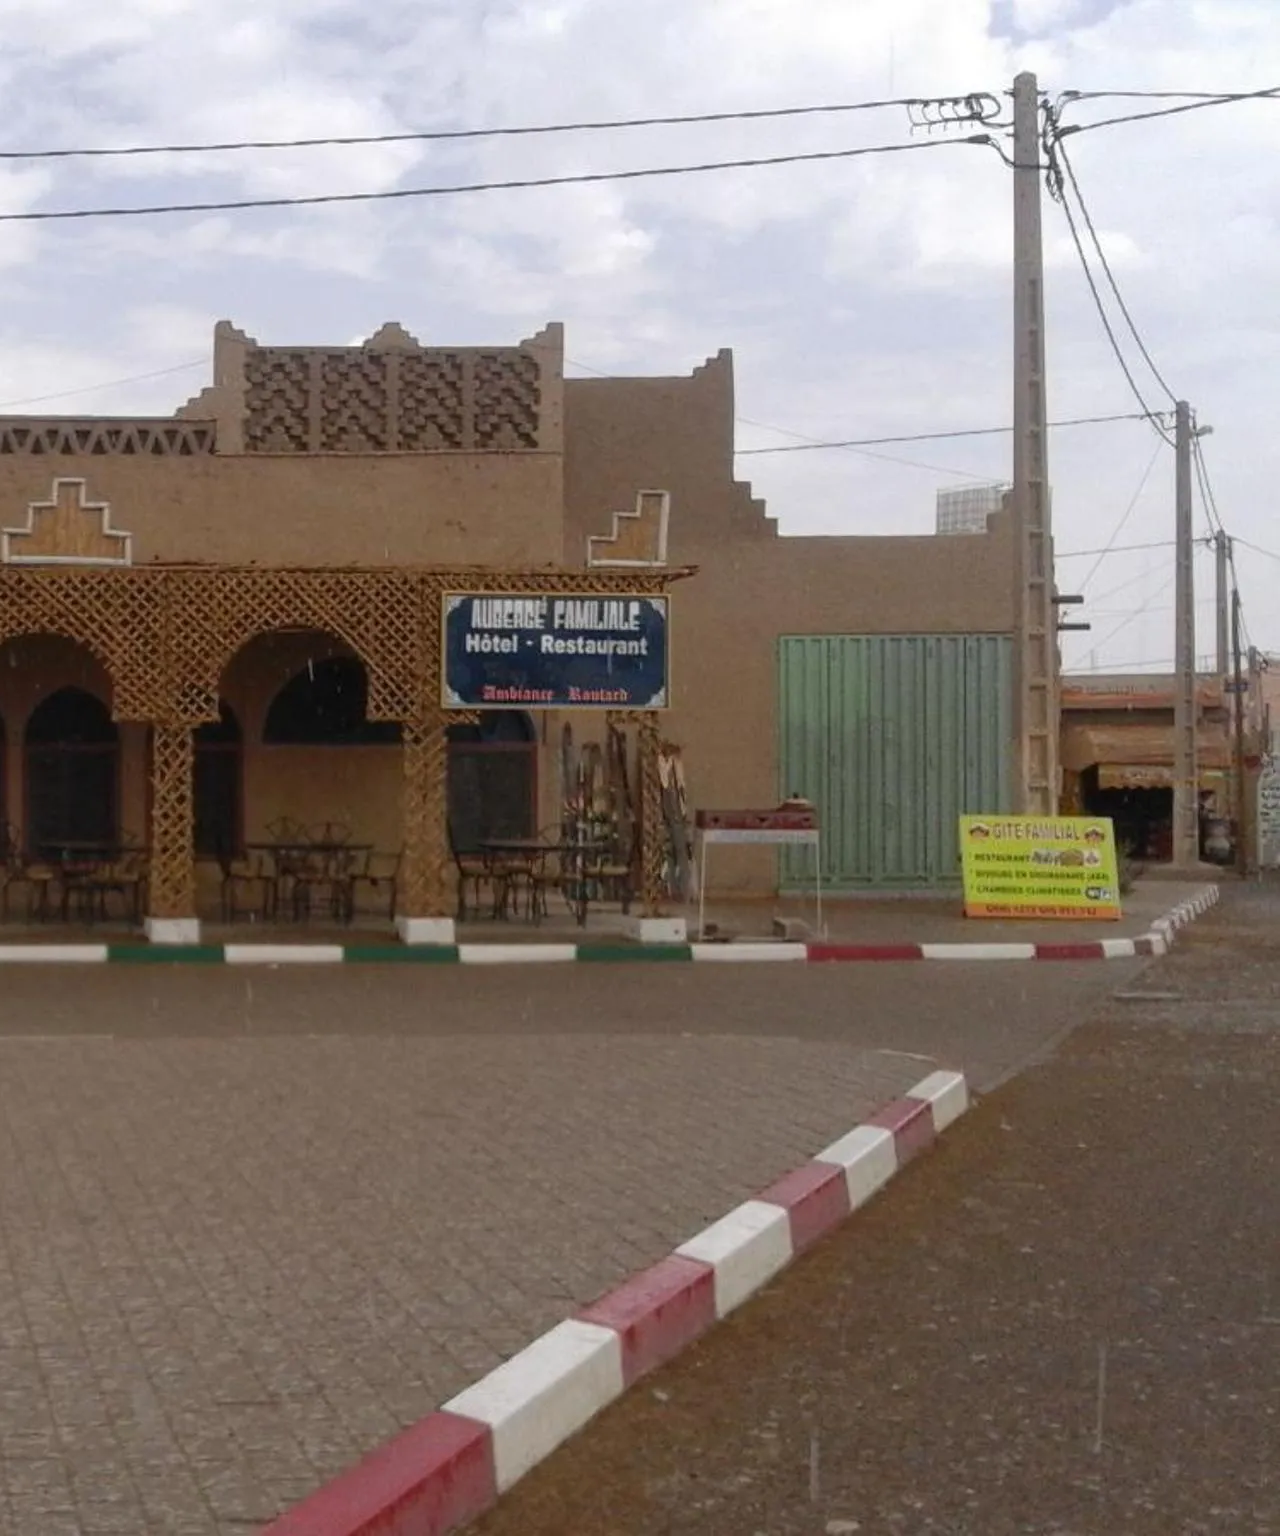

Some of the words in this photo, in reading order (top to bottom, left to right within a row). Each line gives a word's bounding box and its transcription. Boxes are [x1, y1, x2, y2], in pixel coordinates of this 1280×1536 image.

[471, 599, 546, 629] AUBERGE
[554, 600, 641, 631] FAMILIALE
[465, 633, 519, 654] Hôtel
[540, 634, 648, 656] Restaurant
[482, 685, 555, 701] Ambiance
[568, 687, 629, 702] Routard
[992, 822, 1023, 840] GITE
[1025, 823, 1080, 841] FAMILIAL
